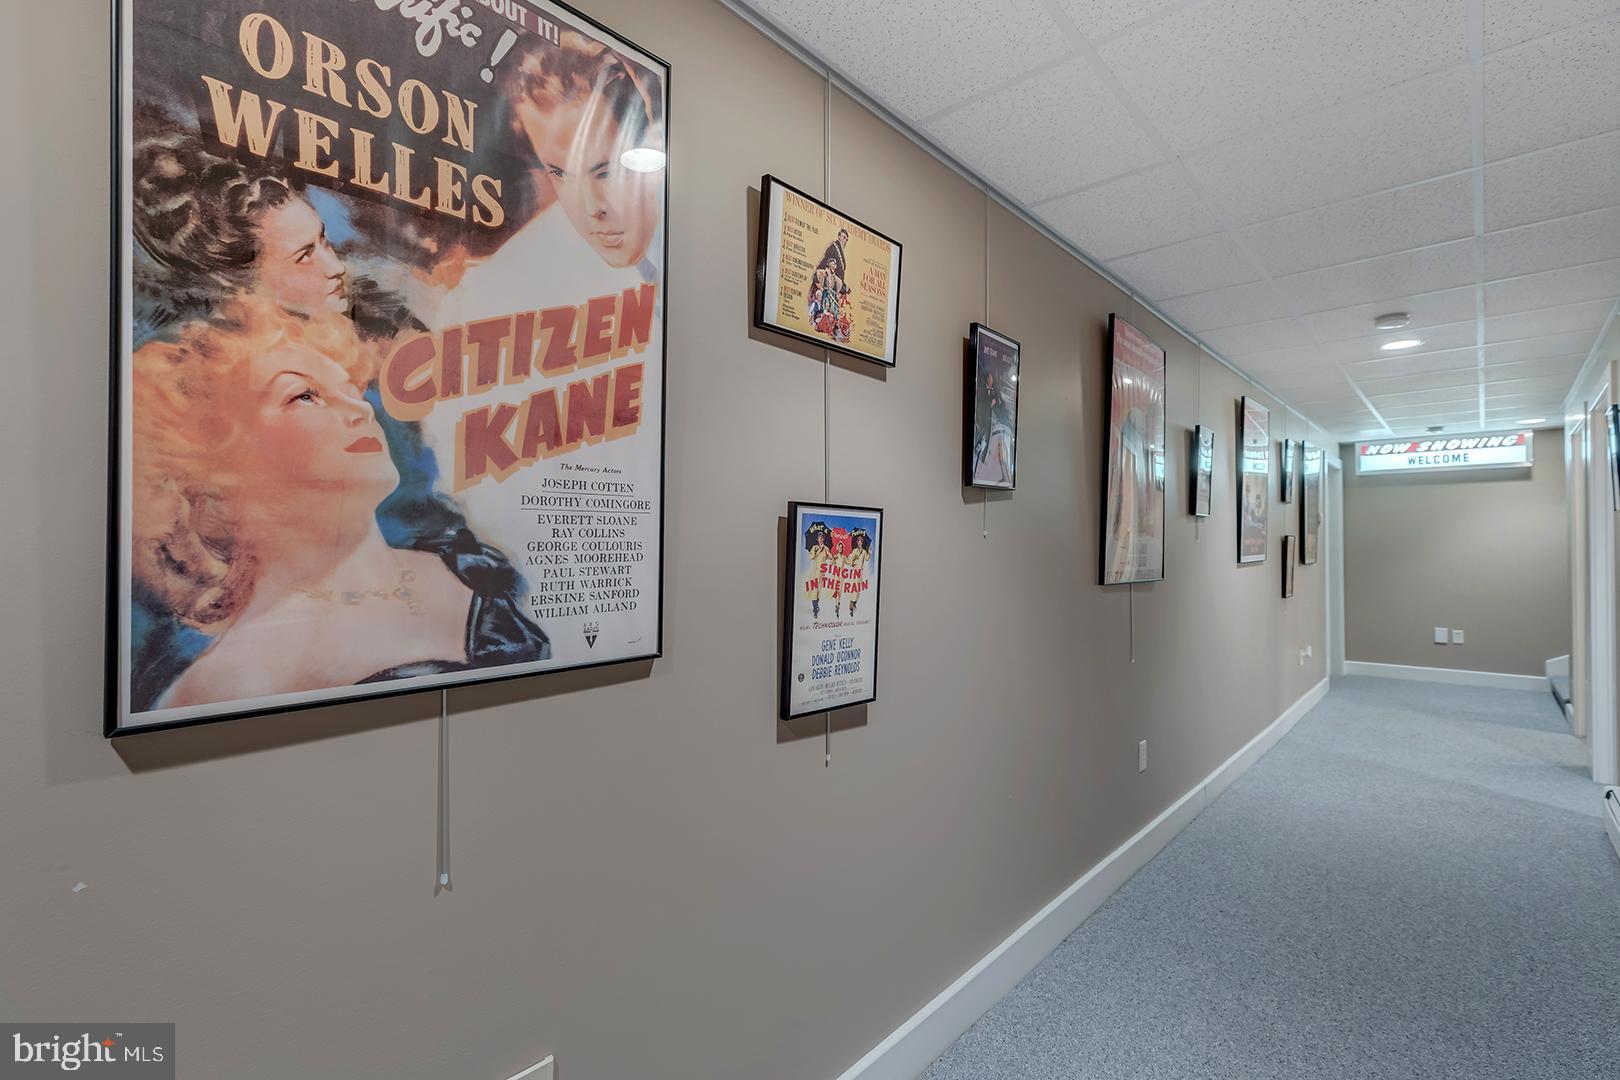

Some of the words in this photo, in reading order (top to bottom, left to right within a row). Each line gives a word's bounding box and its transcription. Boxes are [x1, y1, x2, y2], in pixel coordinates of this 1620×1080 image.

[537, 16, 559, 45] IT!
[239, 13, 478, 153] ORSON
[201, 75, 505, 228] WELLES
[379, 283, 656, 421] CITIZEN
[455, 362, 644, 491] KANE
[1366, 443, 1411, 456] NOW
[1415, 435, 1519, 453] SHOWING
[1408, 453, 1470, 465] WELCOME
[560, 463, 573, 471] The
[574, 464, 600, 474] Mercury
[542, 478, 587, 491] JOSEPH
[590, 482, 634, 493] COTTEN
[521, 495, 582, 507] DOROTHY
[586, 499, 651, 510] COMINGORE
[537, 514, 594, 526] EVERETT
[596, 516, 637, 526] SLOANE
[552, 528, 575, 538] RAY
[578, 528, 625, 538] COLLINS
[527, 541, 578, 552] GEORGE
[581, 541, 643, 551] COULOURIS
[526, 555, 569, 566] AGNES
[574, 552, 644, 564] MOOREHEAD
[543, 568, 575, 578] PAUL
[579, 565, 632, 577] STEWART
[540, 580, 575, 592] RUTH
[580, 577, 632, 590] WARRICK
[805, 578, 819, 592] IN
[821, 577, 840, 591] THE
[843, 580, 869, 593] RAIN
[531, 592, 585, 606] ERSKINE
[589, 589, 640, 601] SANFORD
[534, 605, 588, 619] WILLIAM
[593, 601, 637, 614] ALLAND
[821, 639, 836, 652] GENE
[839, 637, 854, 649] KELLY
[811, 653, 835, 667] DONALD
[811, 665, 832, 680] DEBBIE
[834, 661, 861, 676] REYNOLDS
